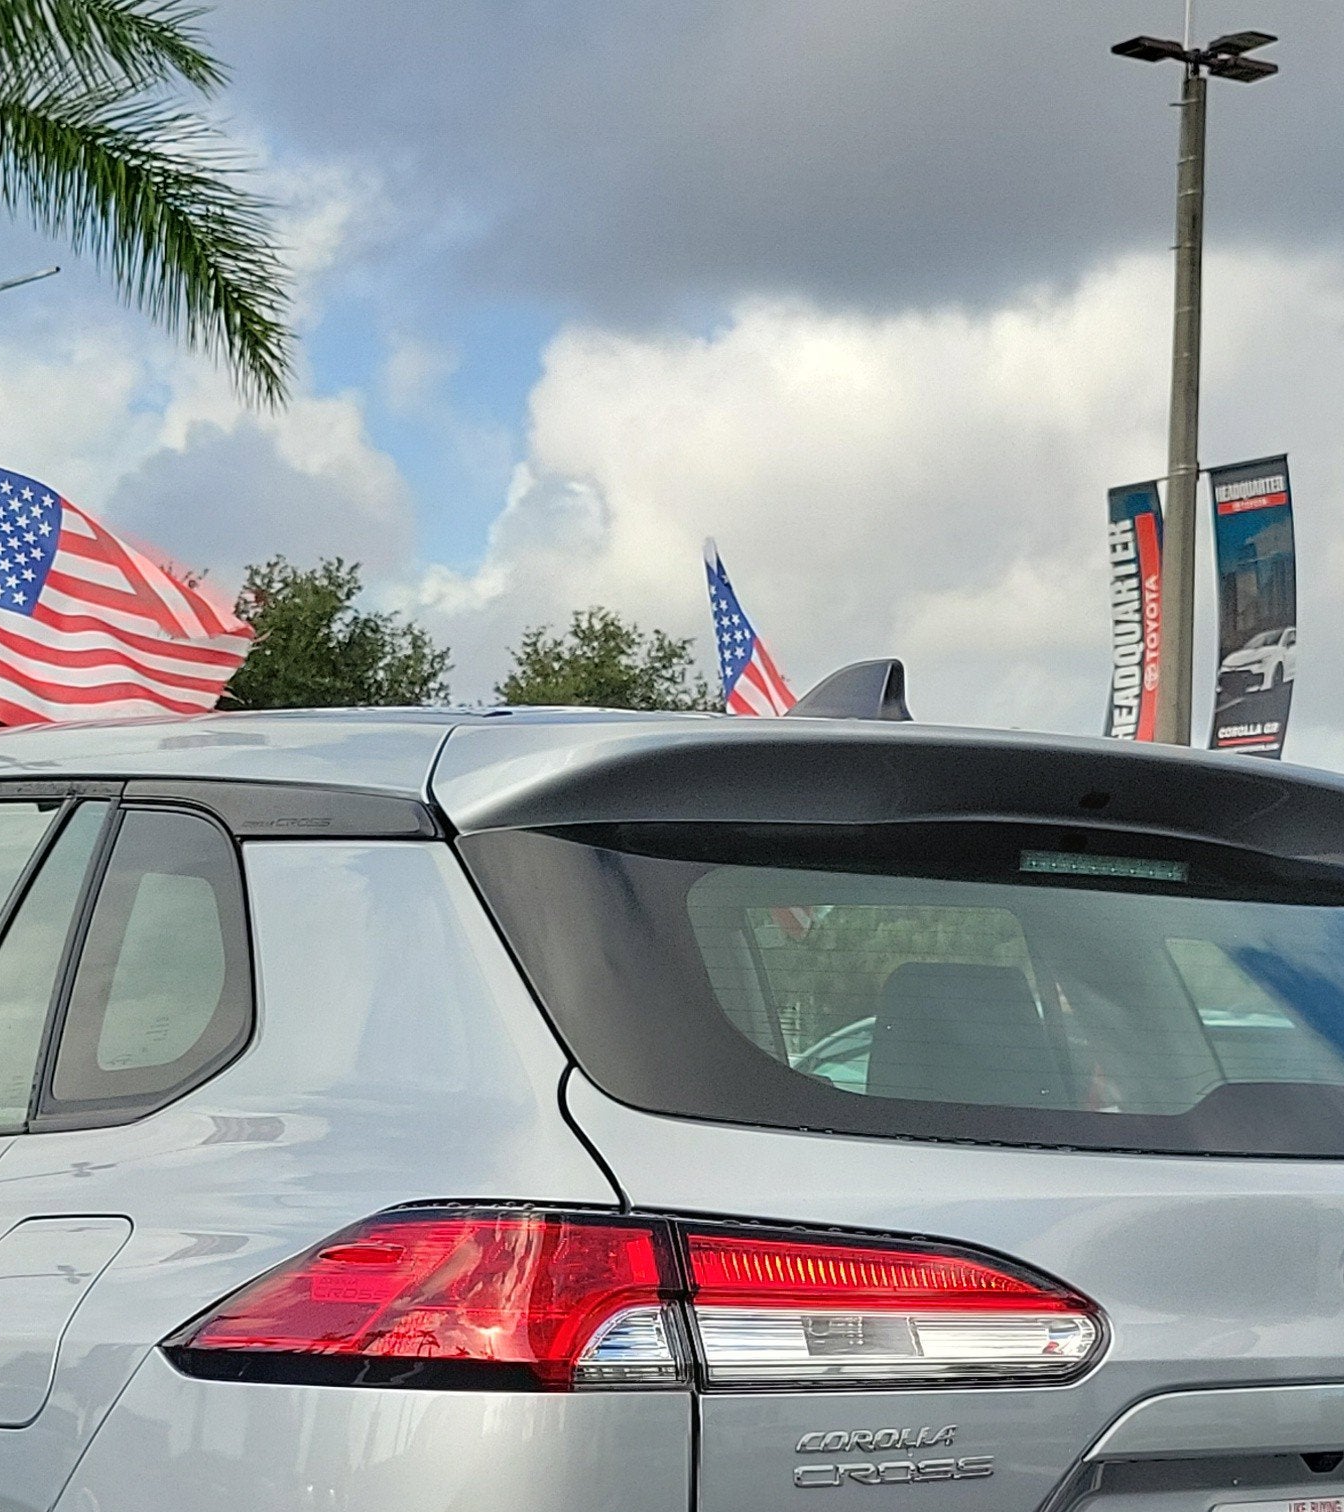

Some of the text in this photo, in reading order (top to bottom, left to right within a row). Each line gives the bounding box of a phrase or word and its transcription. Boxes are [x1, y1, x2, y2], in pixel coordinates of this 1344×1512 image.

[1108, 518, 1143, 740] HEADQUARTER
[1144, 574, 1160, 664] TOYOTA
[795, 1424, 957, 1453] COROLLA
[793, 1455, 995, 1488] CROSS
